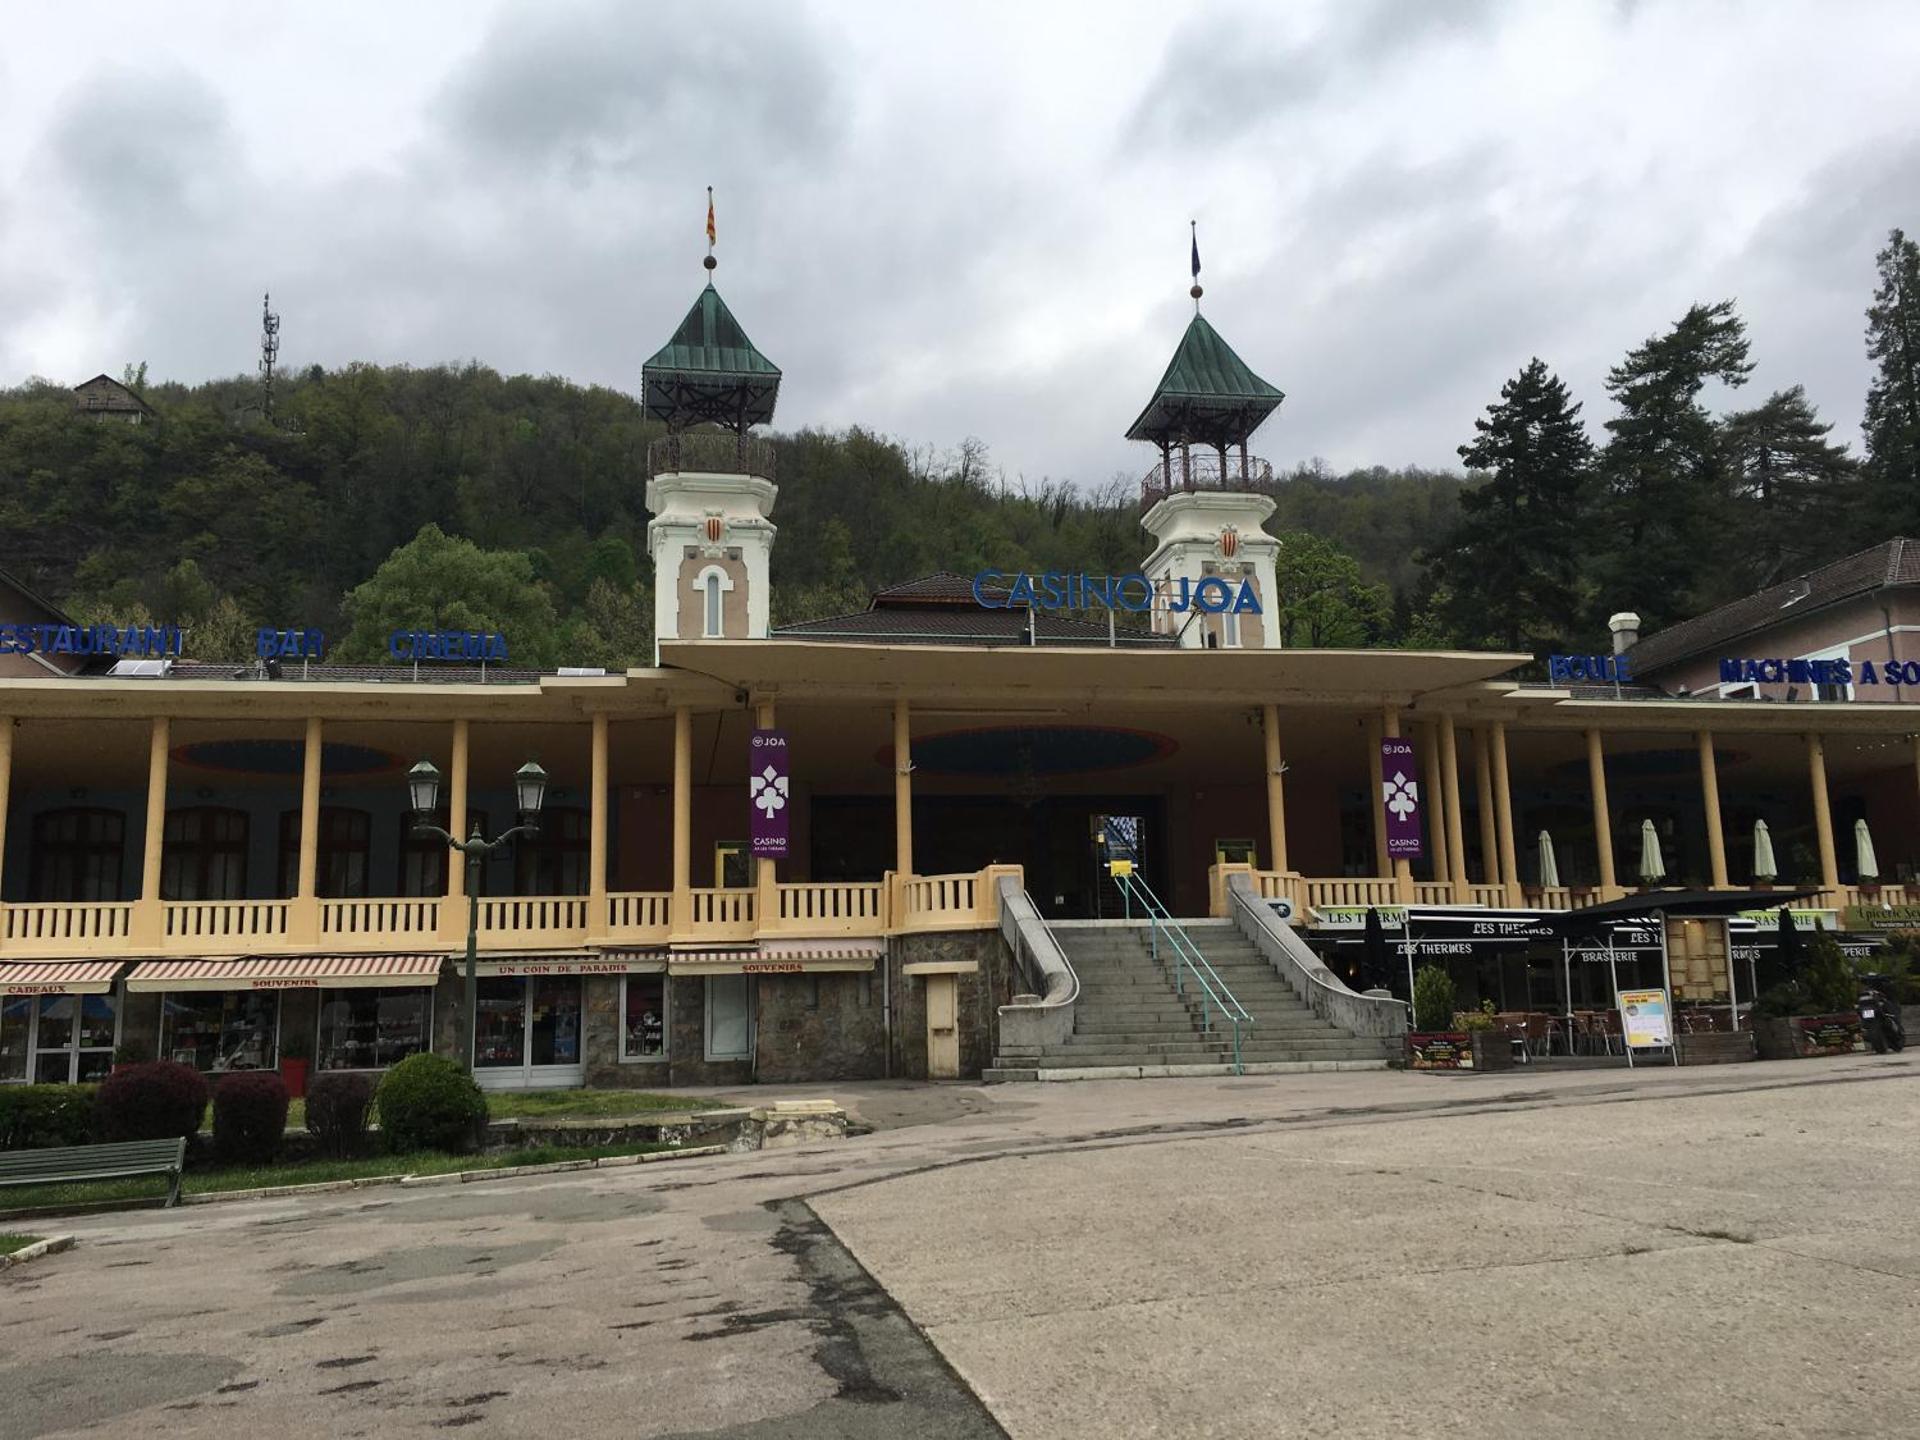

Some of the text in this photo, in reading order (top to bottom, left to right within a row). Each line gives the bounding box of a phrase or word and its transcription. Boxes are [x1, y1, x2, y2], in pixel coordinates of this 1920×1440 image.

[972, 569, 1263, 615] CASINO JOA
[257, 626, 323, 657] BAR
[390, 629, 508, 660] CINEMA
[1551, 655, 1632, 681] BOULE
[1719, 657, 1852, 684] MACHINES
[1860, 660, 1879, 684] A
[764, 738, 786, 746] JOA
[1393, 745, 1412, 754] JOA
[753, 837, 787, 846] CASINO
[1389, 839, 1419, 847] CASINO
[1328, 912, 1353, 923] LES
[1472, 922, 1496, 934] LES
[1630, 933, 1651, 943] LES
[1421, 943, 1472, 954] THERMES
[1581, 951, 1638, 961] BRASERIE
[499, 963, 628, 974] UN COIN DE PARADIS
[742, 963, 803, 972] SOUVENIRS
[252, 979, 319, 988] SOUVENIRS
[8, 985, 66, 993] CADEAUX
